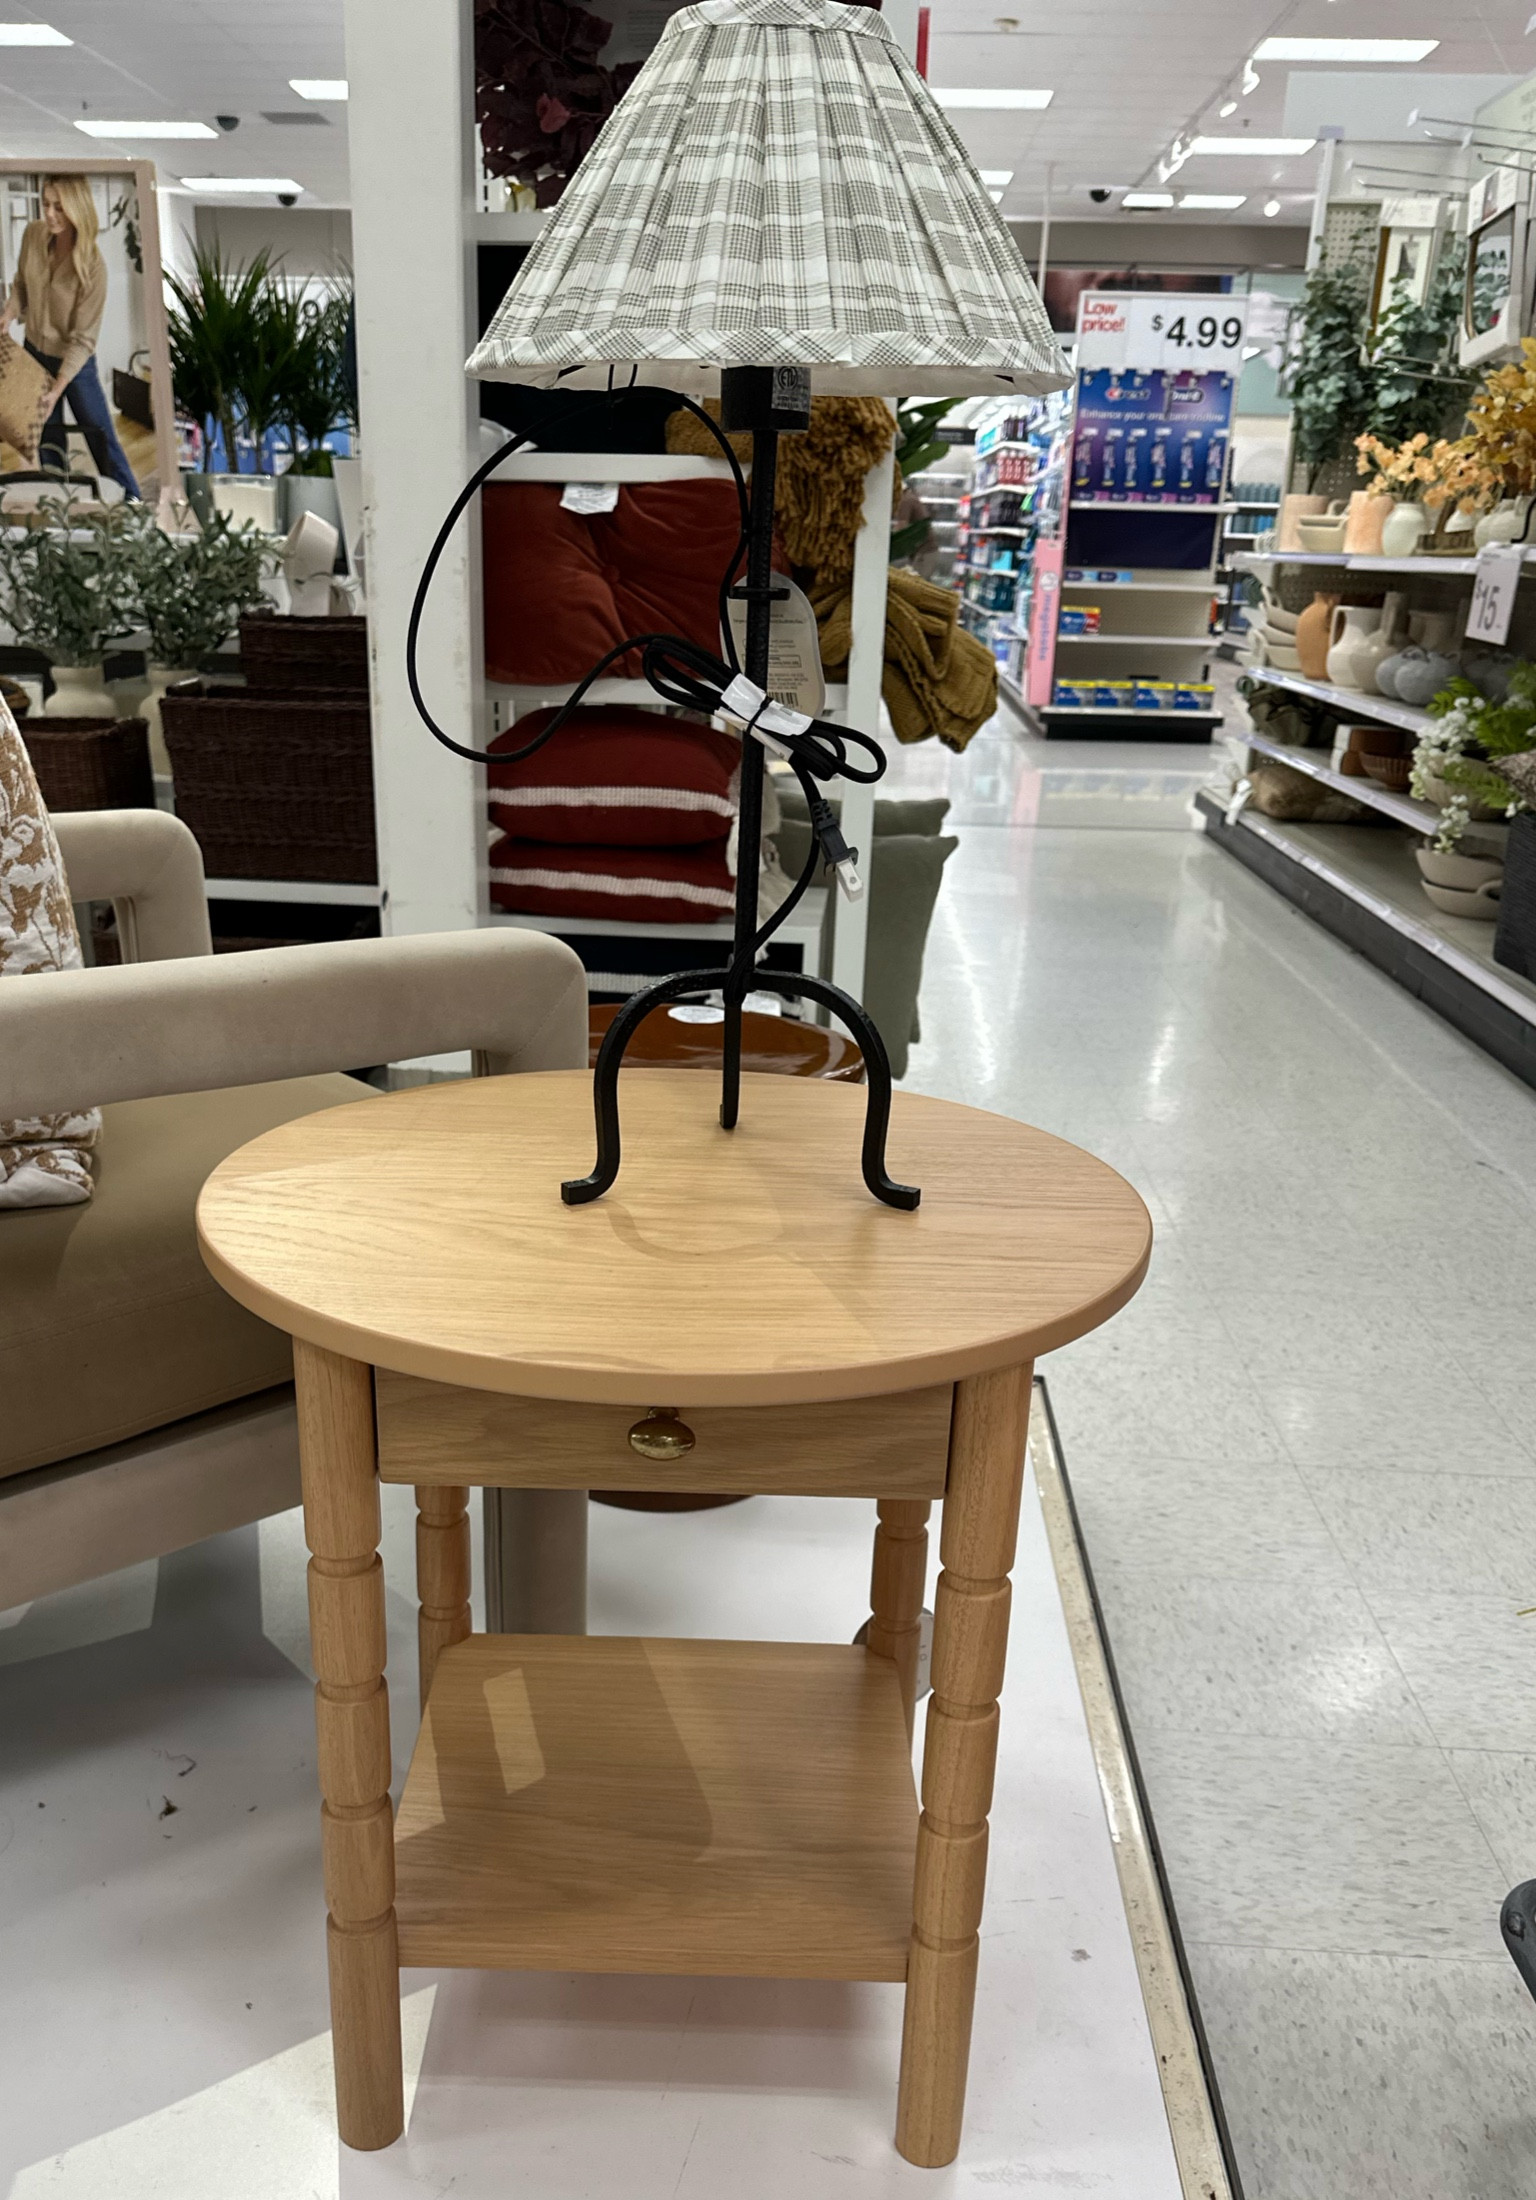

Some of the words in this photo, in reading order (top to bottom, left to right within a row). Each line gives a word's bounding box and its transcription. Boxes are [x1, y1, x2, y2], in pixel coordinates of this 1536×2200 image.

[1083, 300, 1118, 314] Low
[1082, 317, 1126, 333] price!
[1152, 315, 1242, 349] $4.99
